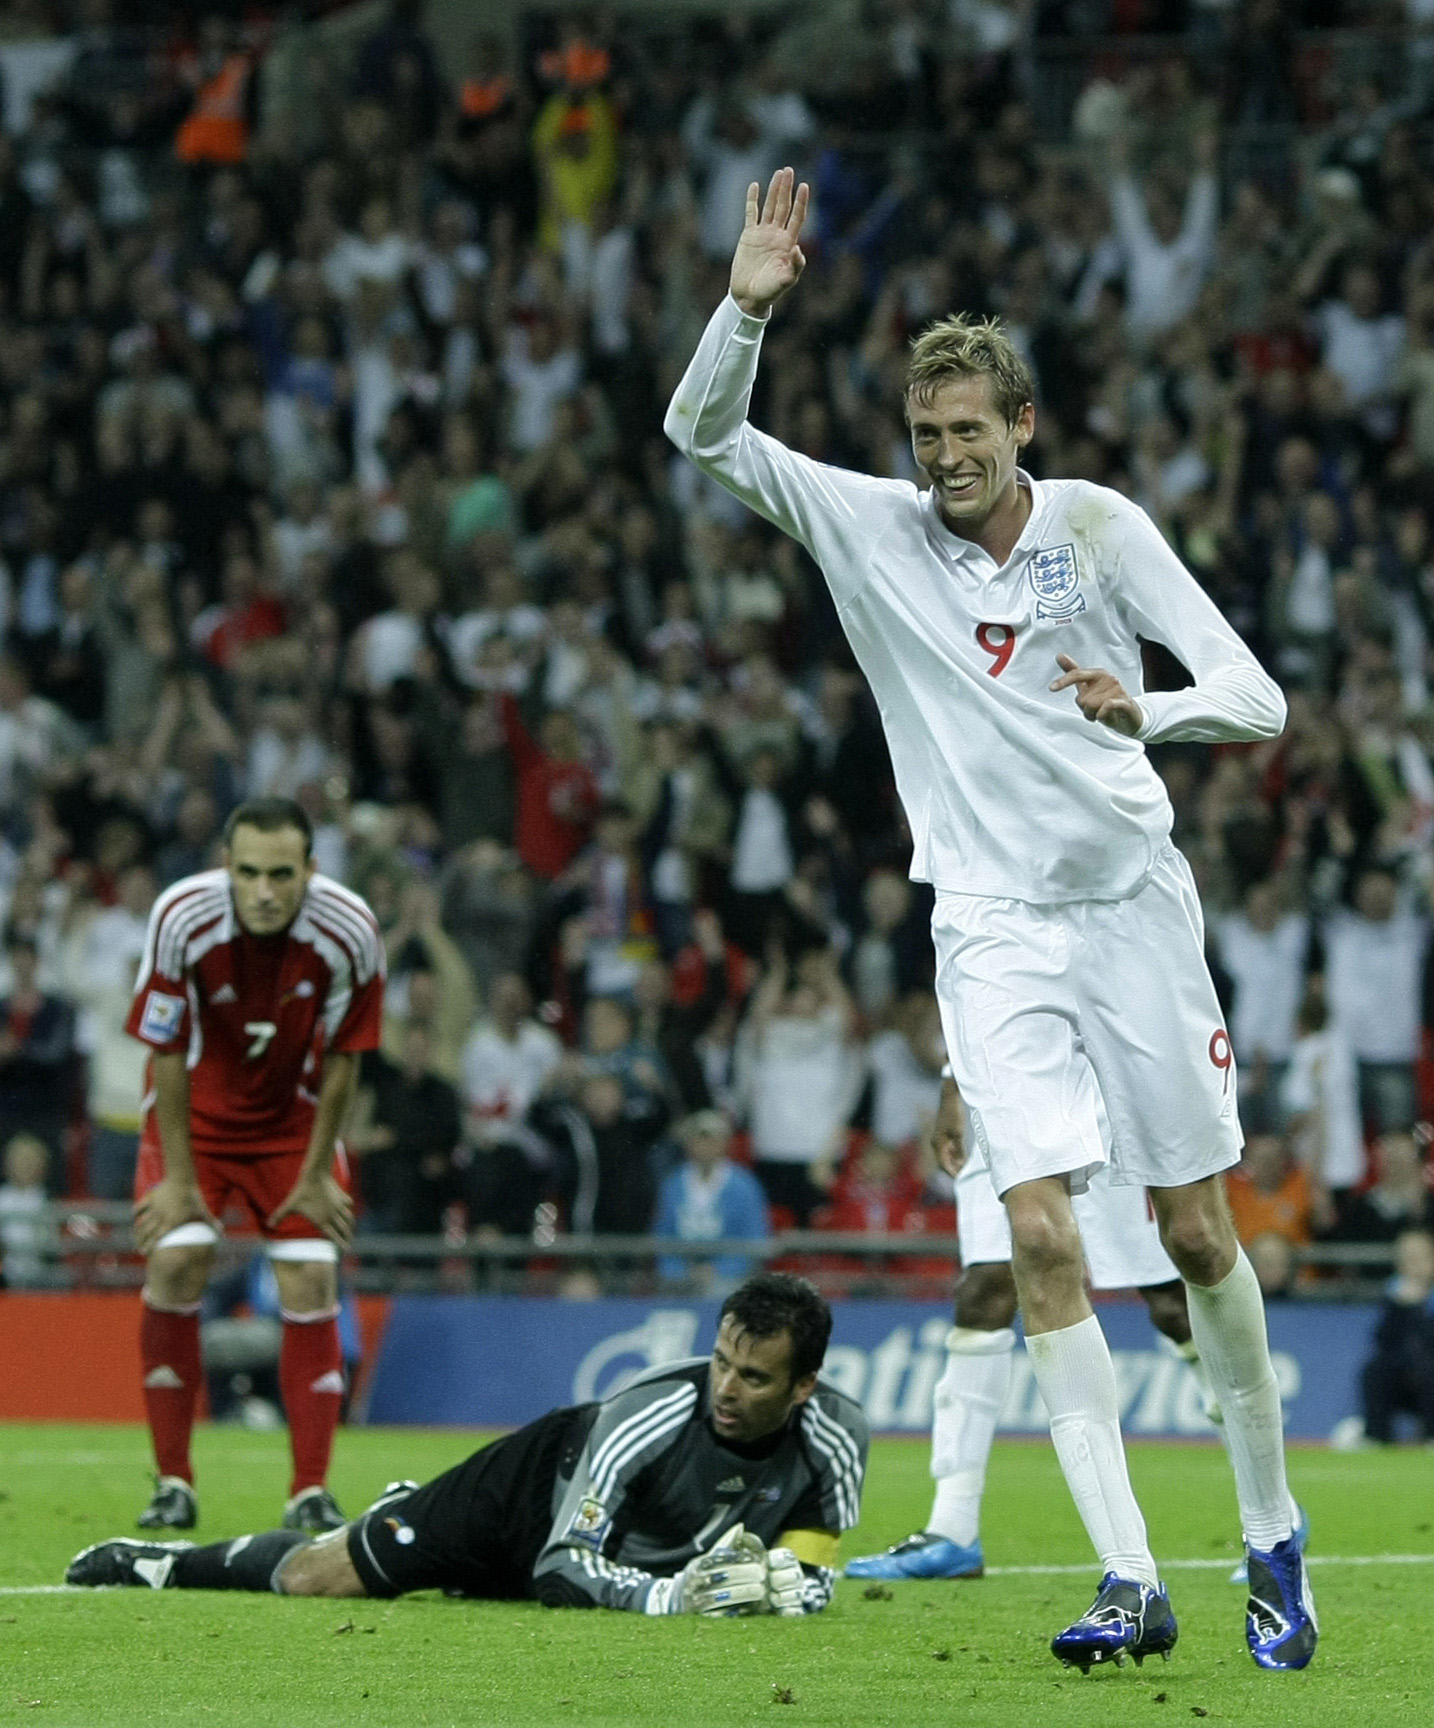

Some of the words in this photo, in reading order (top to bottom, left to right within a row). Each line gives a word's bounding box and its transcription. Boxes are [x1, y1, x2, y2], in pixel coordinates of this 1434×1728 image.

[975, 622, 1016, 678] 9
[244, 1022, 278, 1059] 7
[1208, 1028, 1232, 1096] 9
